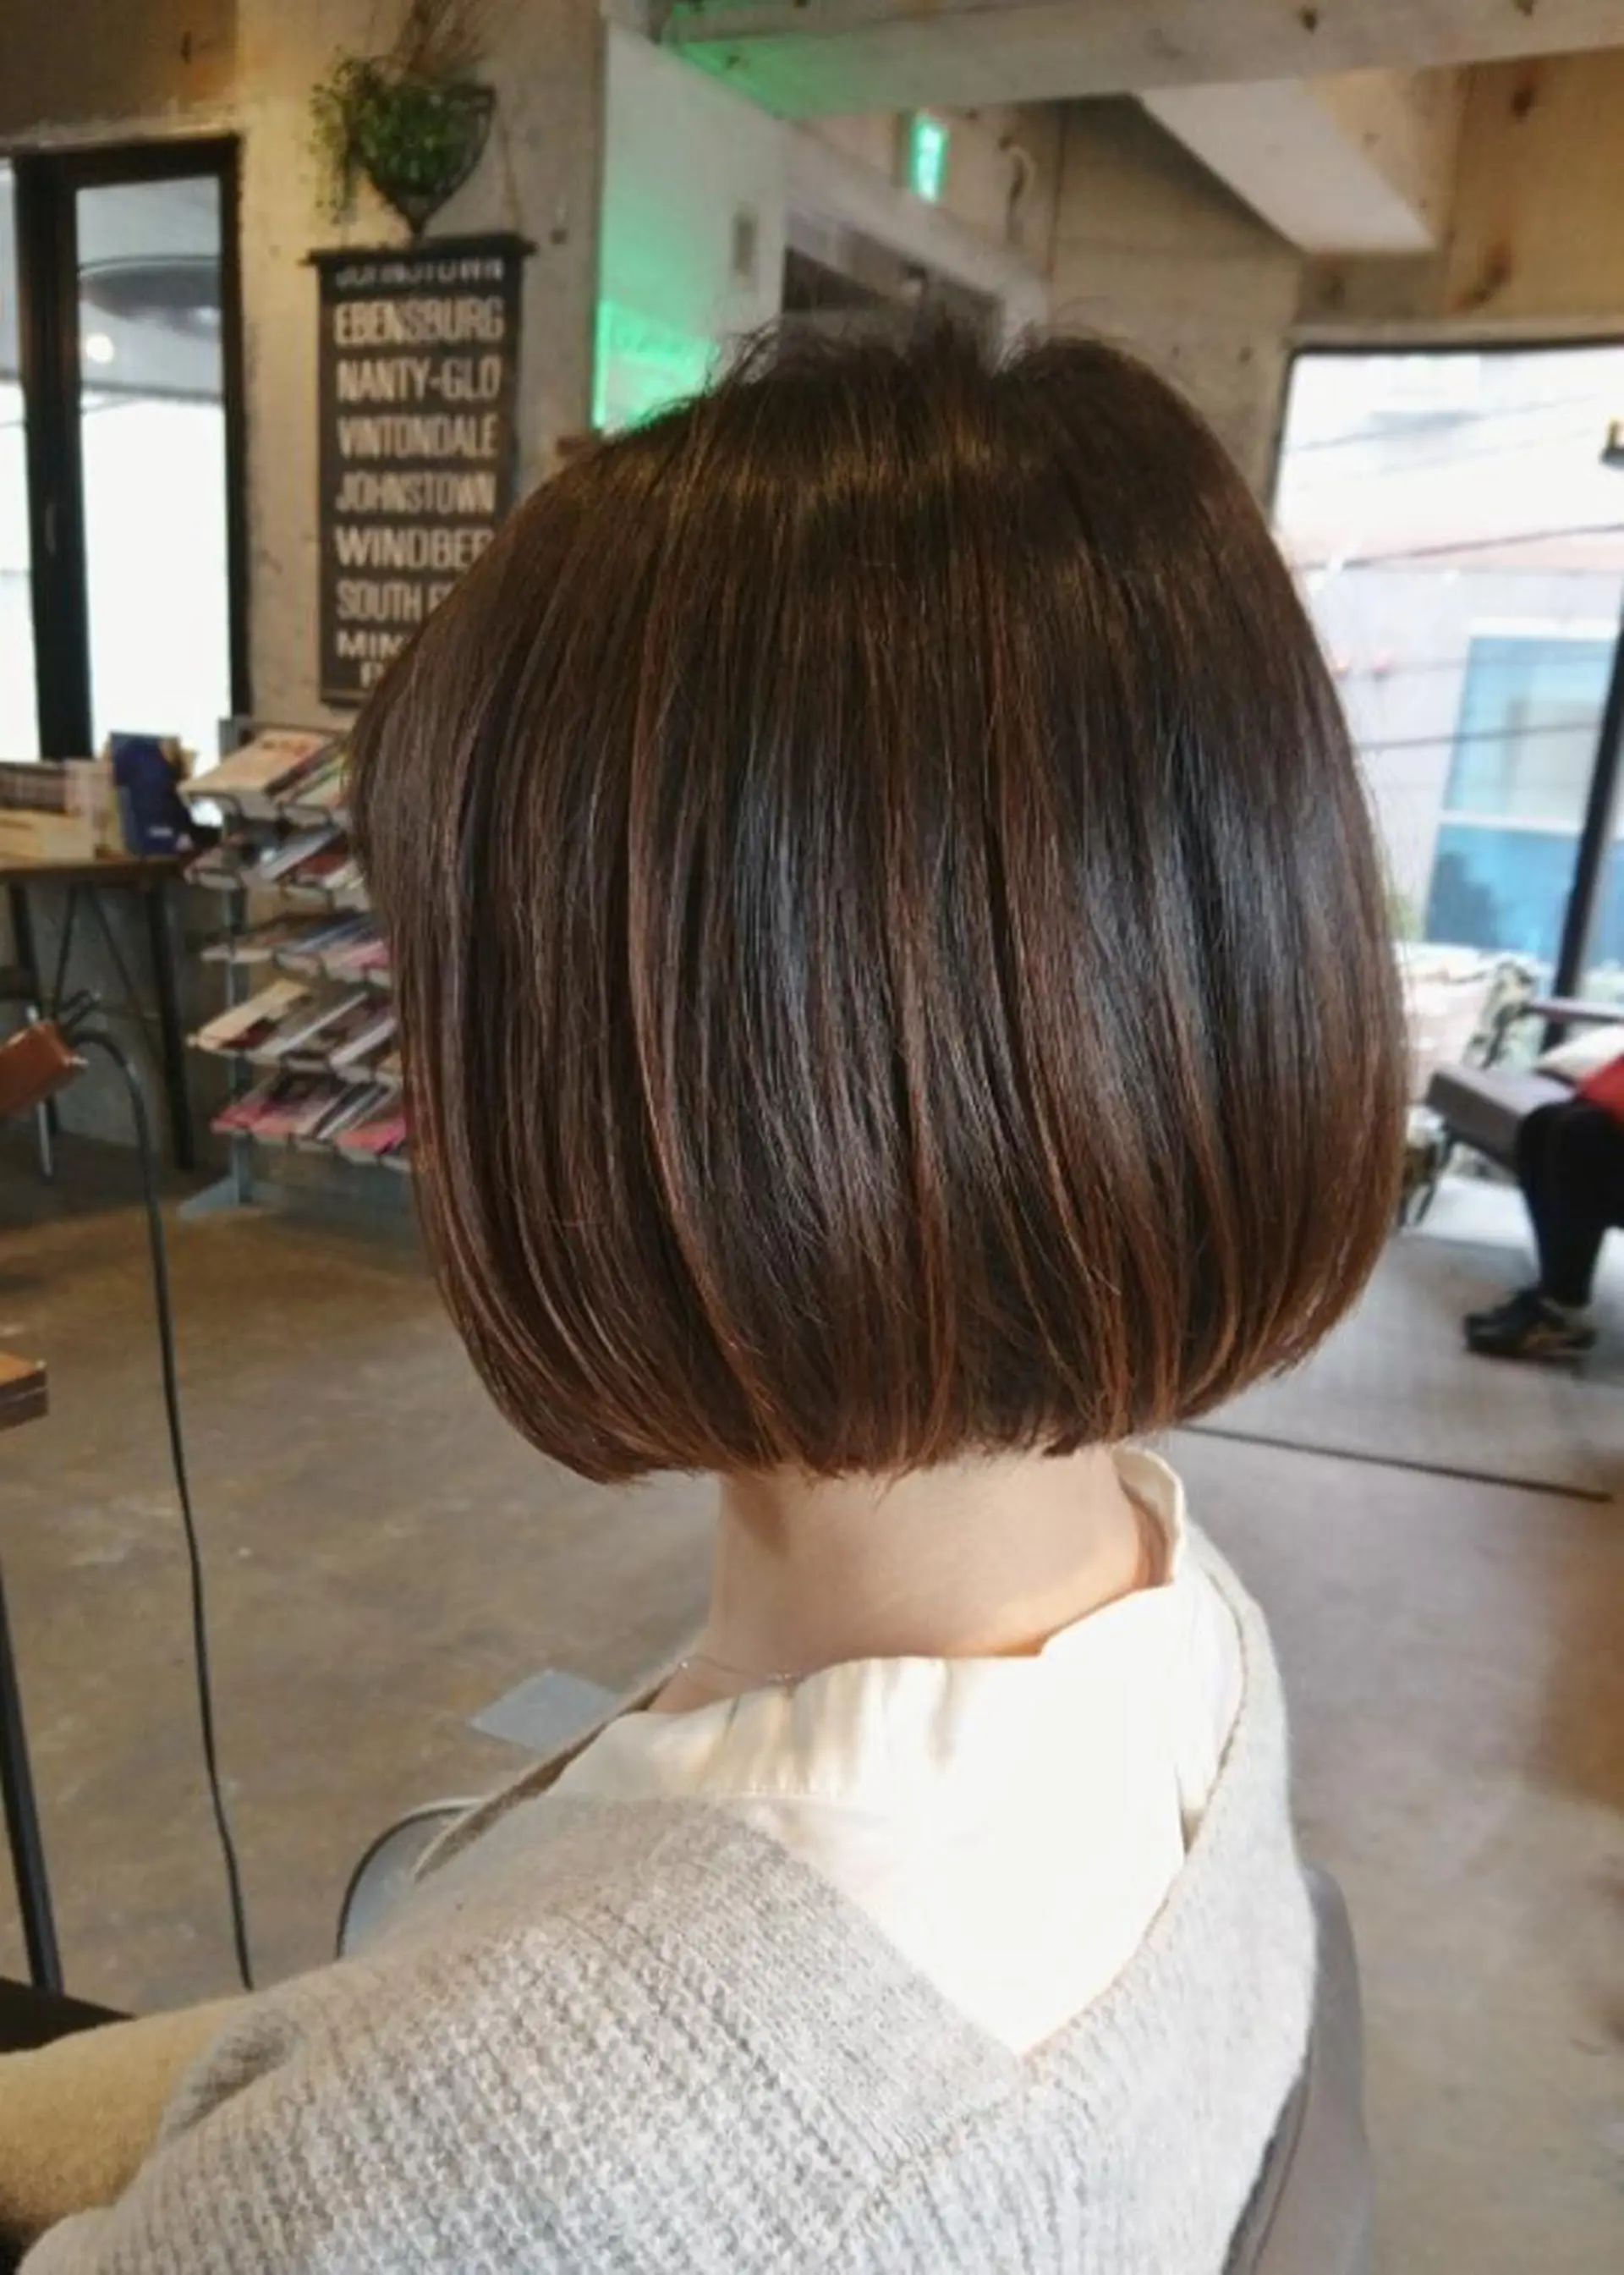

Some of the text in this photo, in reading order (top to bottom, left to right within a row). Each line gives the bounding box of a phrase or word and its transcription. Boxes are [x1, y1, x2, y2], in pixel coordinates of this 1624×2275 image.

[334, 296, 504, 346] EBENSBURG
[337, 354, 502, 402] NANTY-GLO
[337, 412, 498, 459] VINTONDALE
[336, 471, 497, 514] JOHNSTOWN
[337, 579, 424, 623] SOUTH
